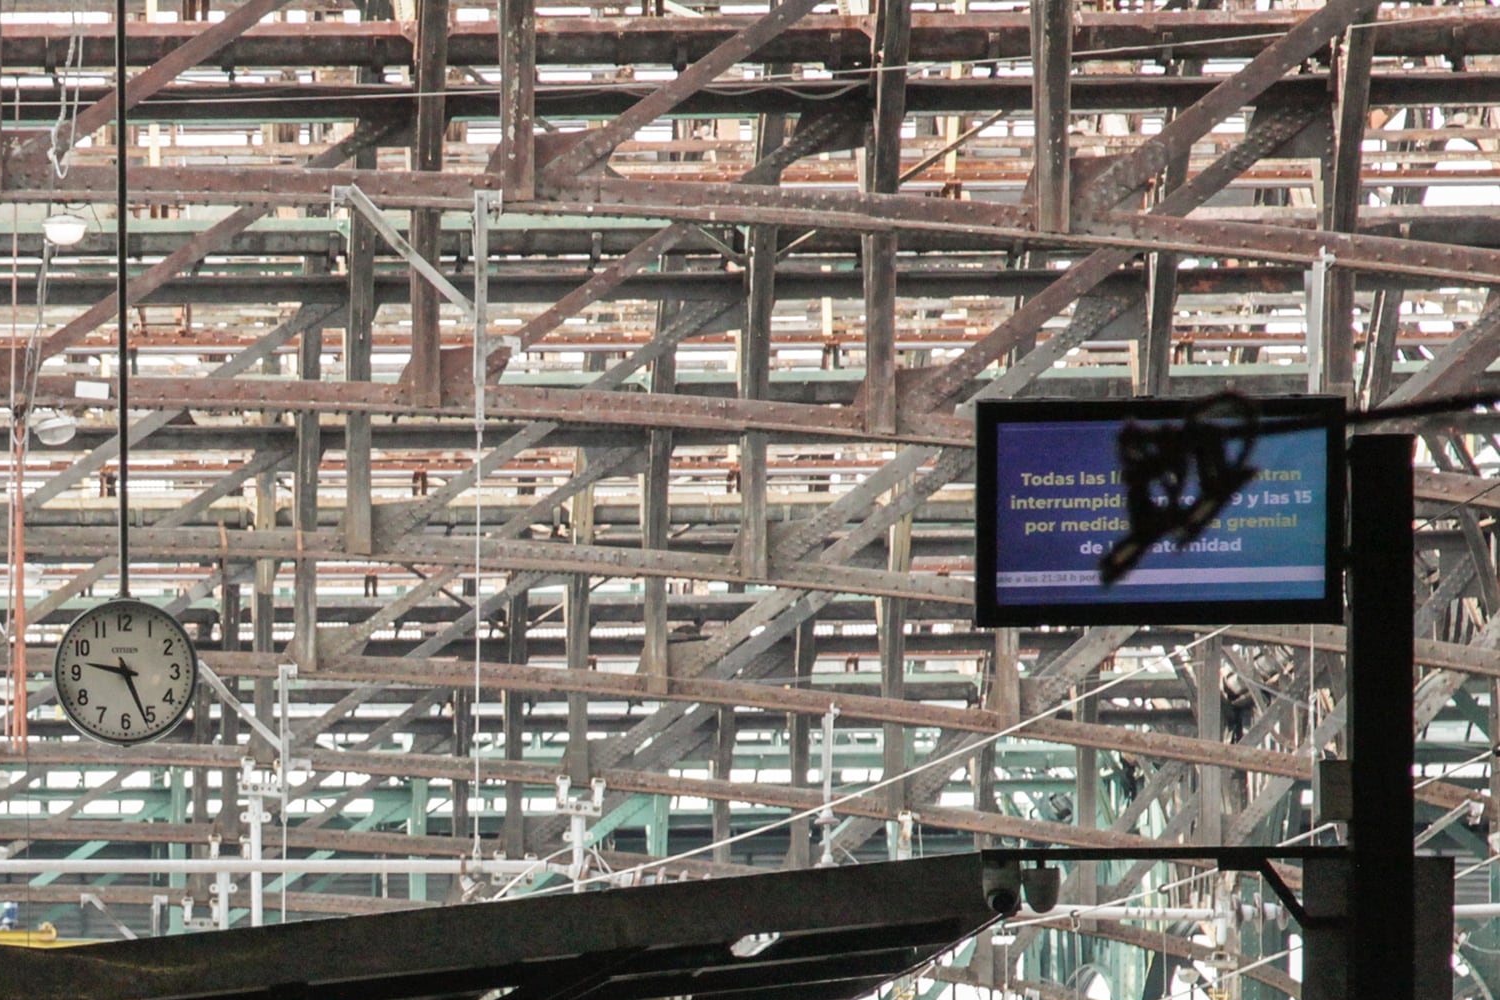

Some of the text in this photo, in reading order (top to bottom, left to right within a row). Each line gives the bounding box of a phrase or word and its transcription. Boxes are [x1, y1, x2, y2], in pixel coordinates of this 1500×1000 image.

[1021, 472, 1075, 486] Todas
[1080, 471, 1106, 485] las
[1010, 489, 1313, 511] interrumpid 9 y las 15
[1025, 519, 1055, 536] por
[1061, 515, 1131, 532] medida
[1227, 512, 1298, 532] gremial
[1079, 540, 1103, 555] de
[95, 620, 106, 638] 11
[117, 614, 133, 632] 12
[148, 620, 152, 638] 1
[75, 639, 90, 656] 10
[163, 638, 173, 655] 2
[71, 664, 81, 681] 9
[169, 663, 181, 680] 3
[77, 689, 89, 706] 8
[162, 688, 174, 705] 4
[96, 706, 107, 724] 7
[121, 713, 131, 730] 6
[145, 706, 156, 723] 5
